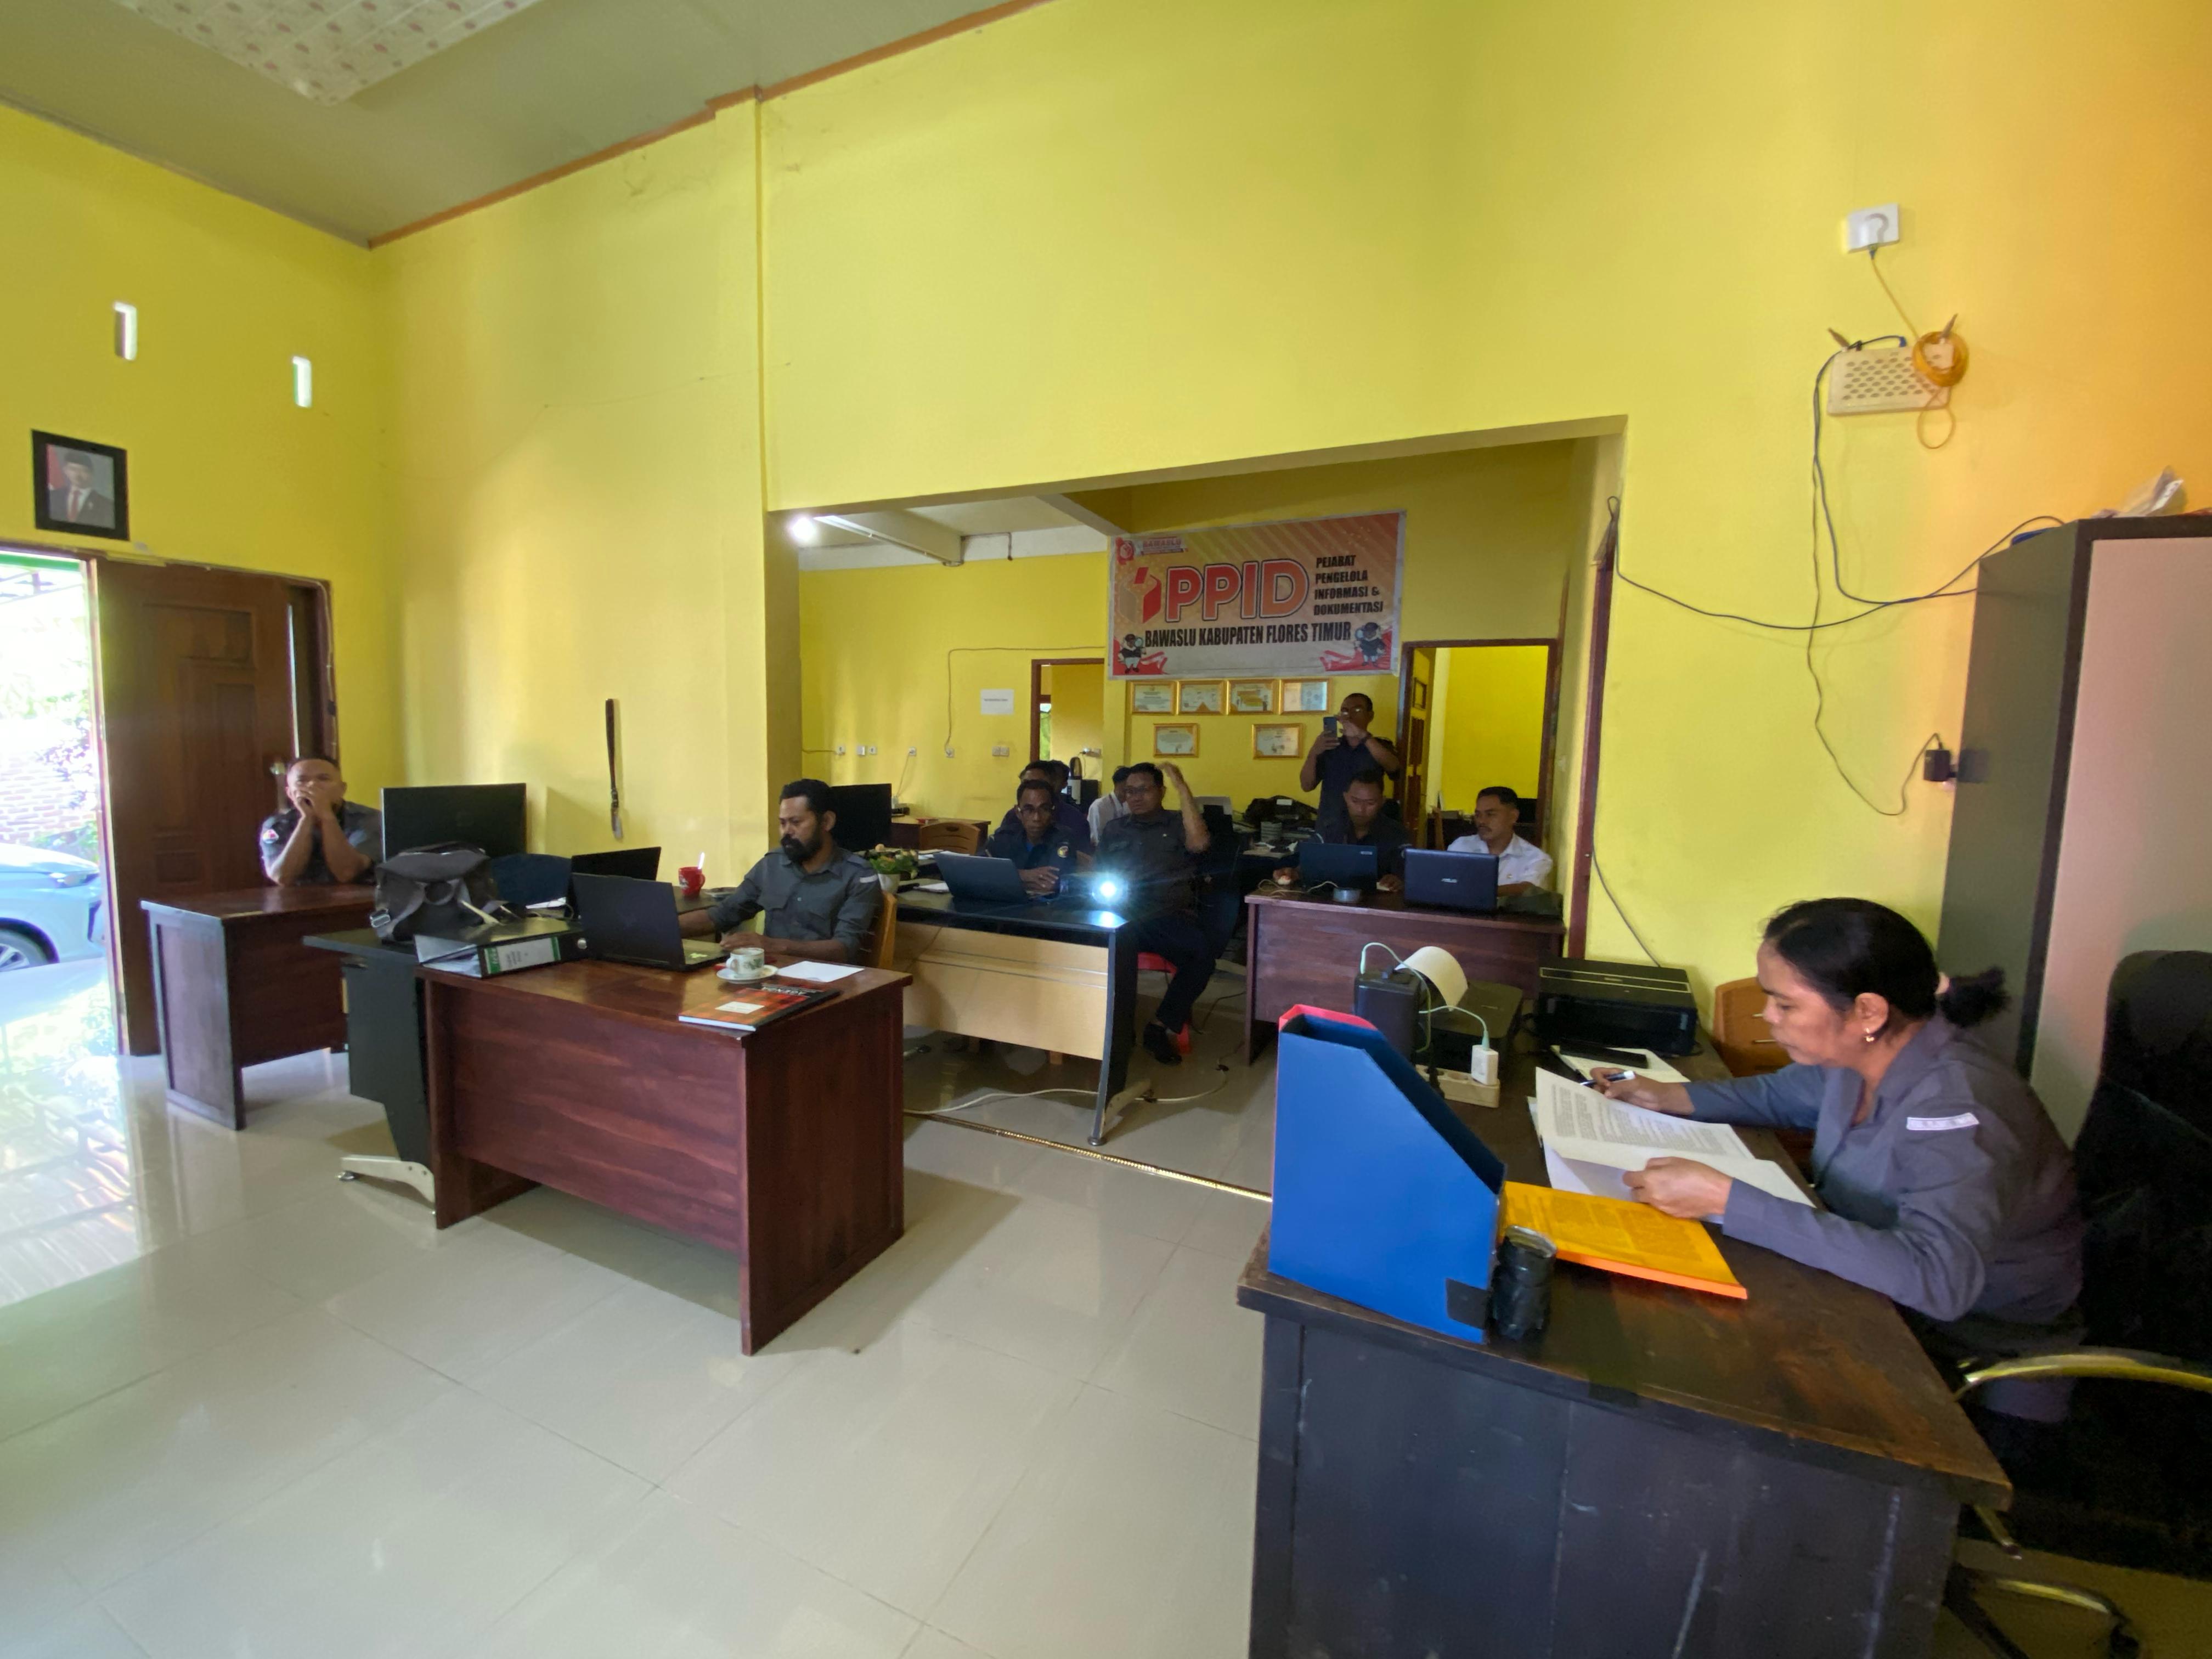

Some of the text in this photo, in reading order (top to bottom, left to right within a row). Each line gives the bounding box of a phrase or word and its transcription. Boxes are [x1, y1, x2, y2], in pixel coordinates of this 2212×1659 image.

[1316, 555, 1356, 568] PEJABAT
[1316, 570, 1368, 584] PENGELOLA
[1165, 558, 1310, 623] PPID
[1314, 586, 1379, 600] INFORMASI &
[1314, 601, 1383, 616] DOKUMENTASI
[1145, 622, 1351, 647] BAWASLU KABUPATEN FLORES TIMUR
